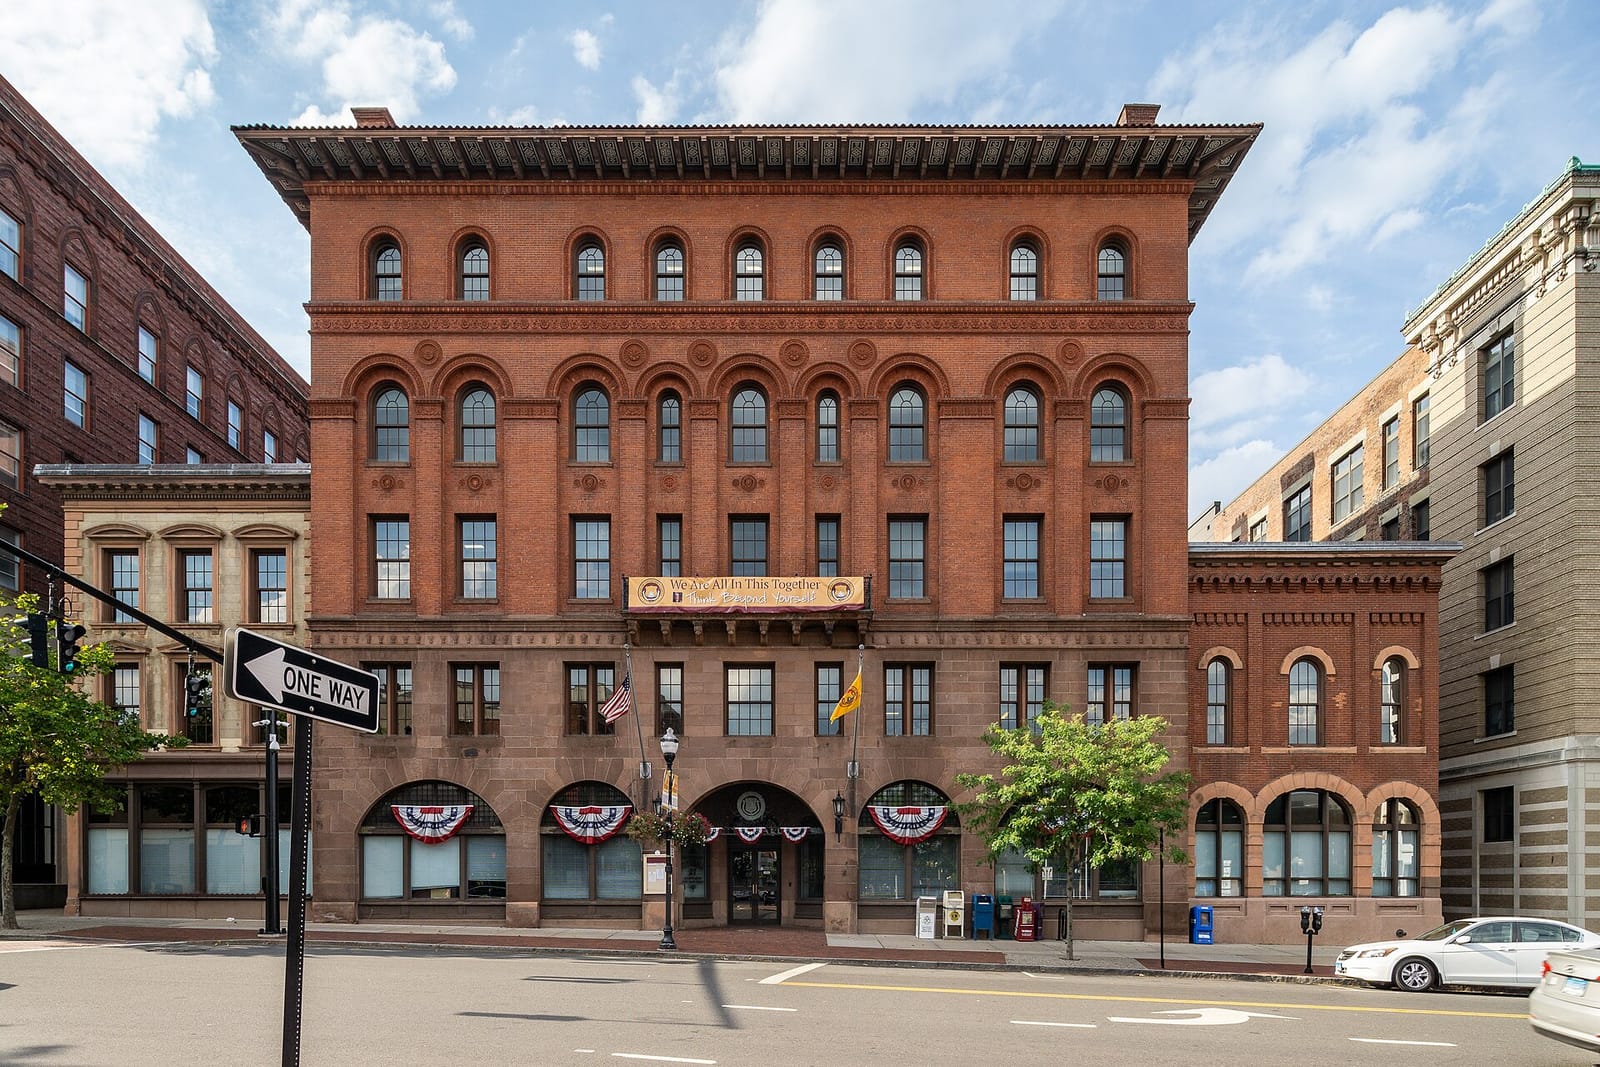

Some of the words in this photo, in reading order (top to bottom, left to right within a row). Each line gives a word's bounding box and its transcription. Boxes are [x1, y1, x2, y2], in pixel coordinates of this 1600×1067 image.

[670, 579, 687, 589] We
[690, 580, 709, 590] Are
[712, 579, 728, 589] All
[731, 579, 742, 589] In
[745, 578, 769, 589] This
[772, 578, 821, 591] Together
[687, 592, 717, 604] Think
[721, 591, 767, 608] Beyond
[773, 591, 816, 604] Yourself
[284, 666, 322, 699] ONE
[329, 679, 365, 710] WAY
